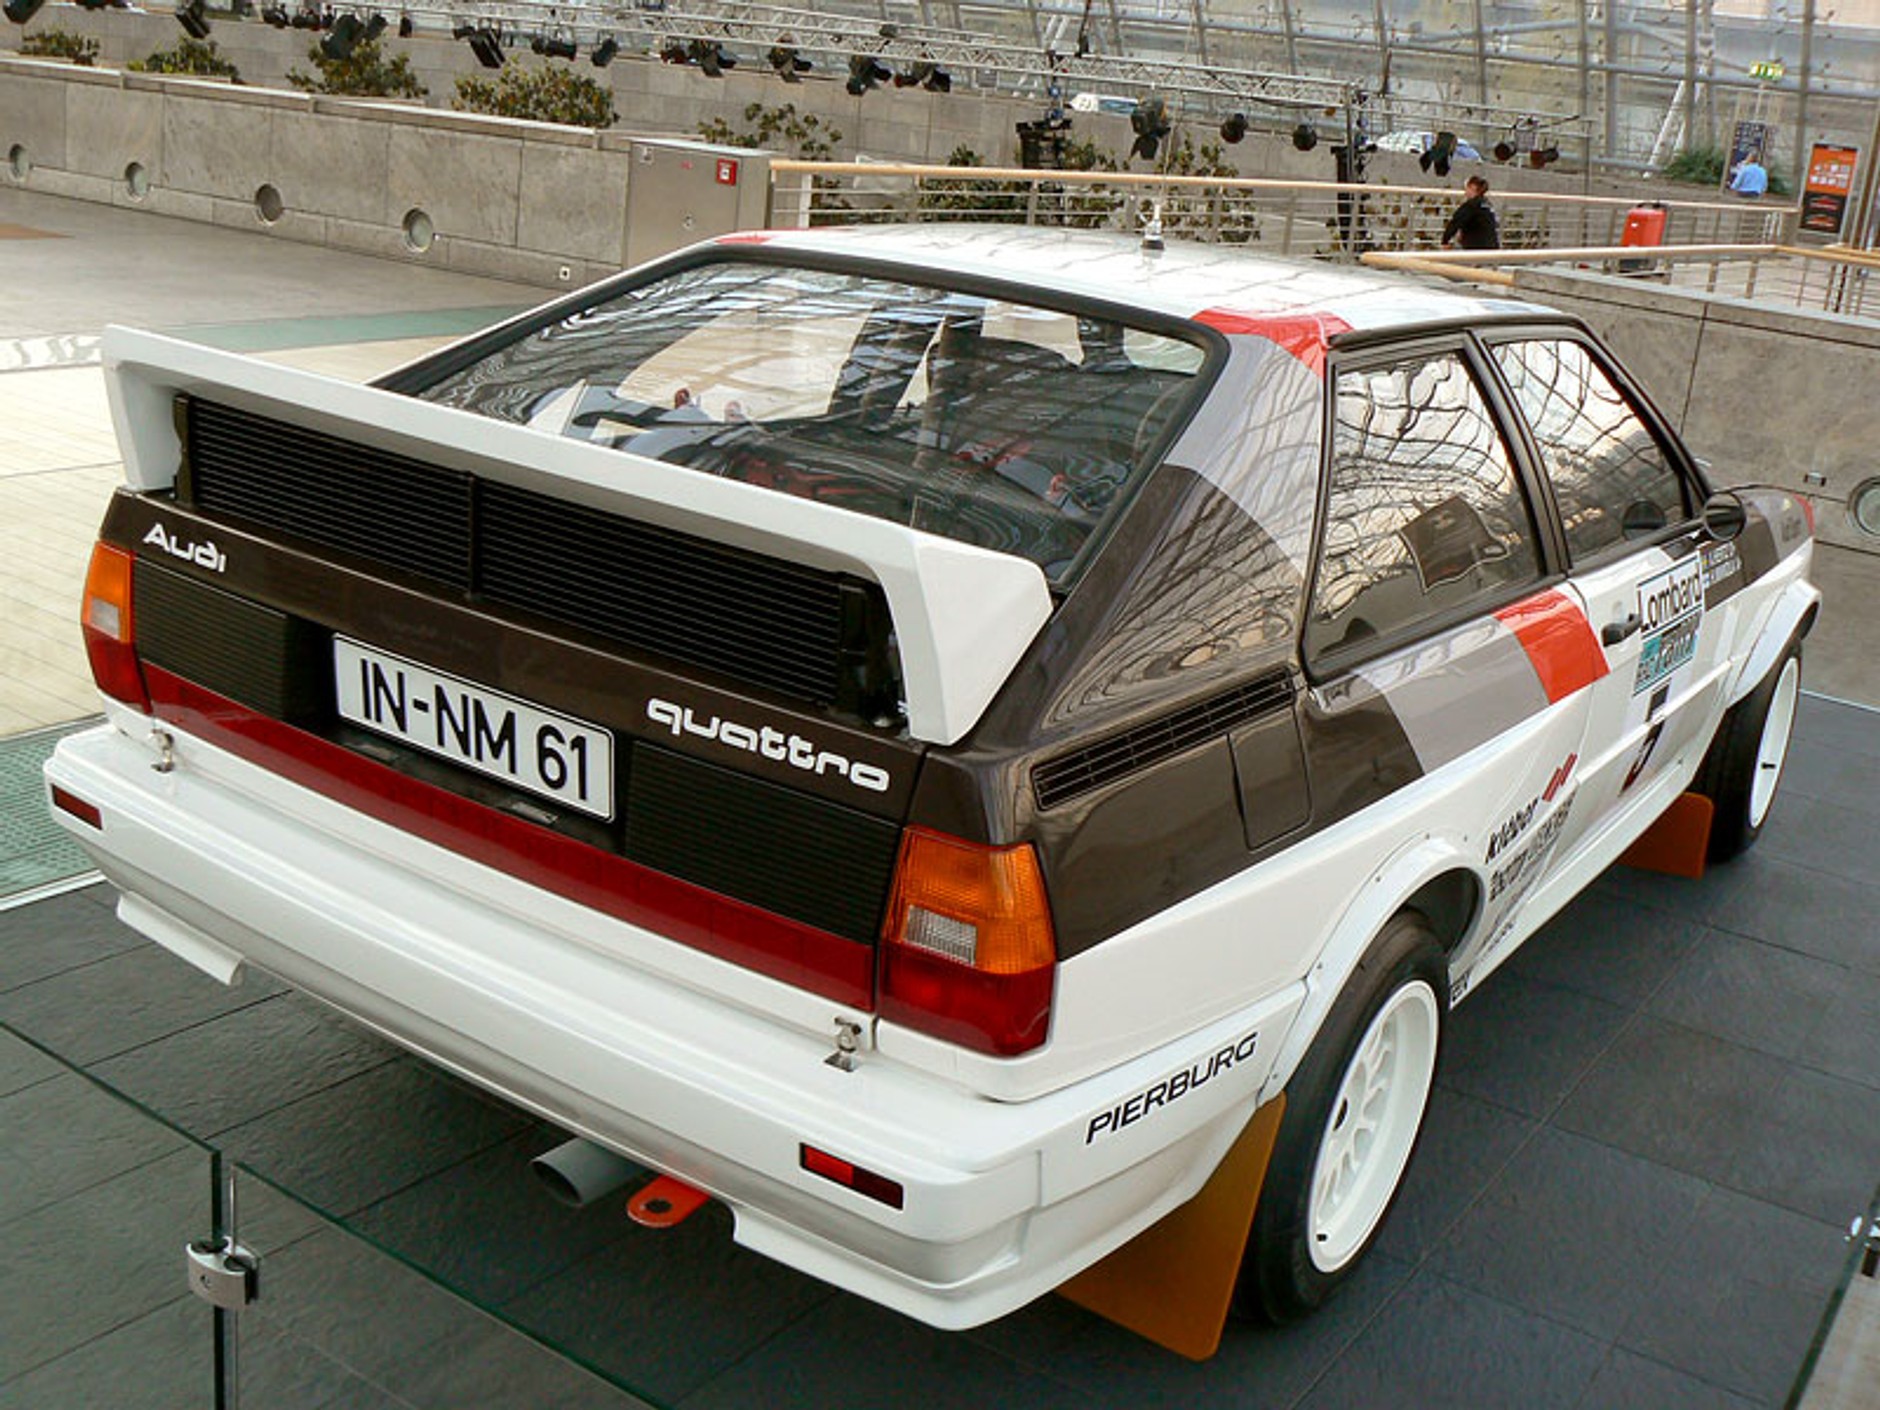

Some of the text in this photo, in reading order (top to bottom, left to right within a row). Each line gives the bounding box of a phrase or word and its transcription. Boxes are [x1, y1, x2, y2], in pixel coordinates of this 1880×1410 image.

[143, 523, 227, 572] Audi
[1638, 562, 1702, 633] Lombard
[361, 658, 590, 801] IN-NM 61
[647, 698, 890, 792] quattro
[1087, 1033, 1258, 1145] PIERBURG
